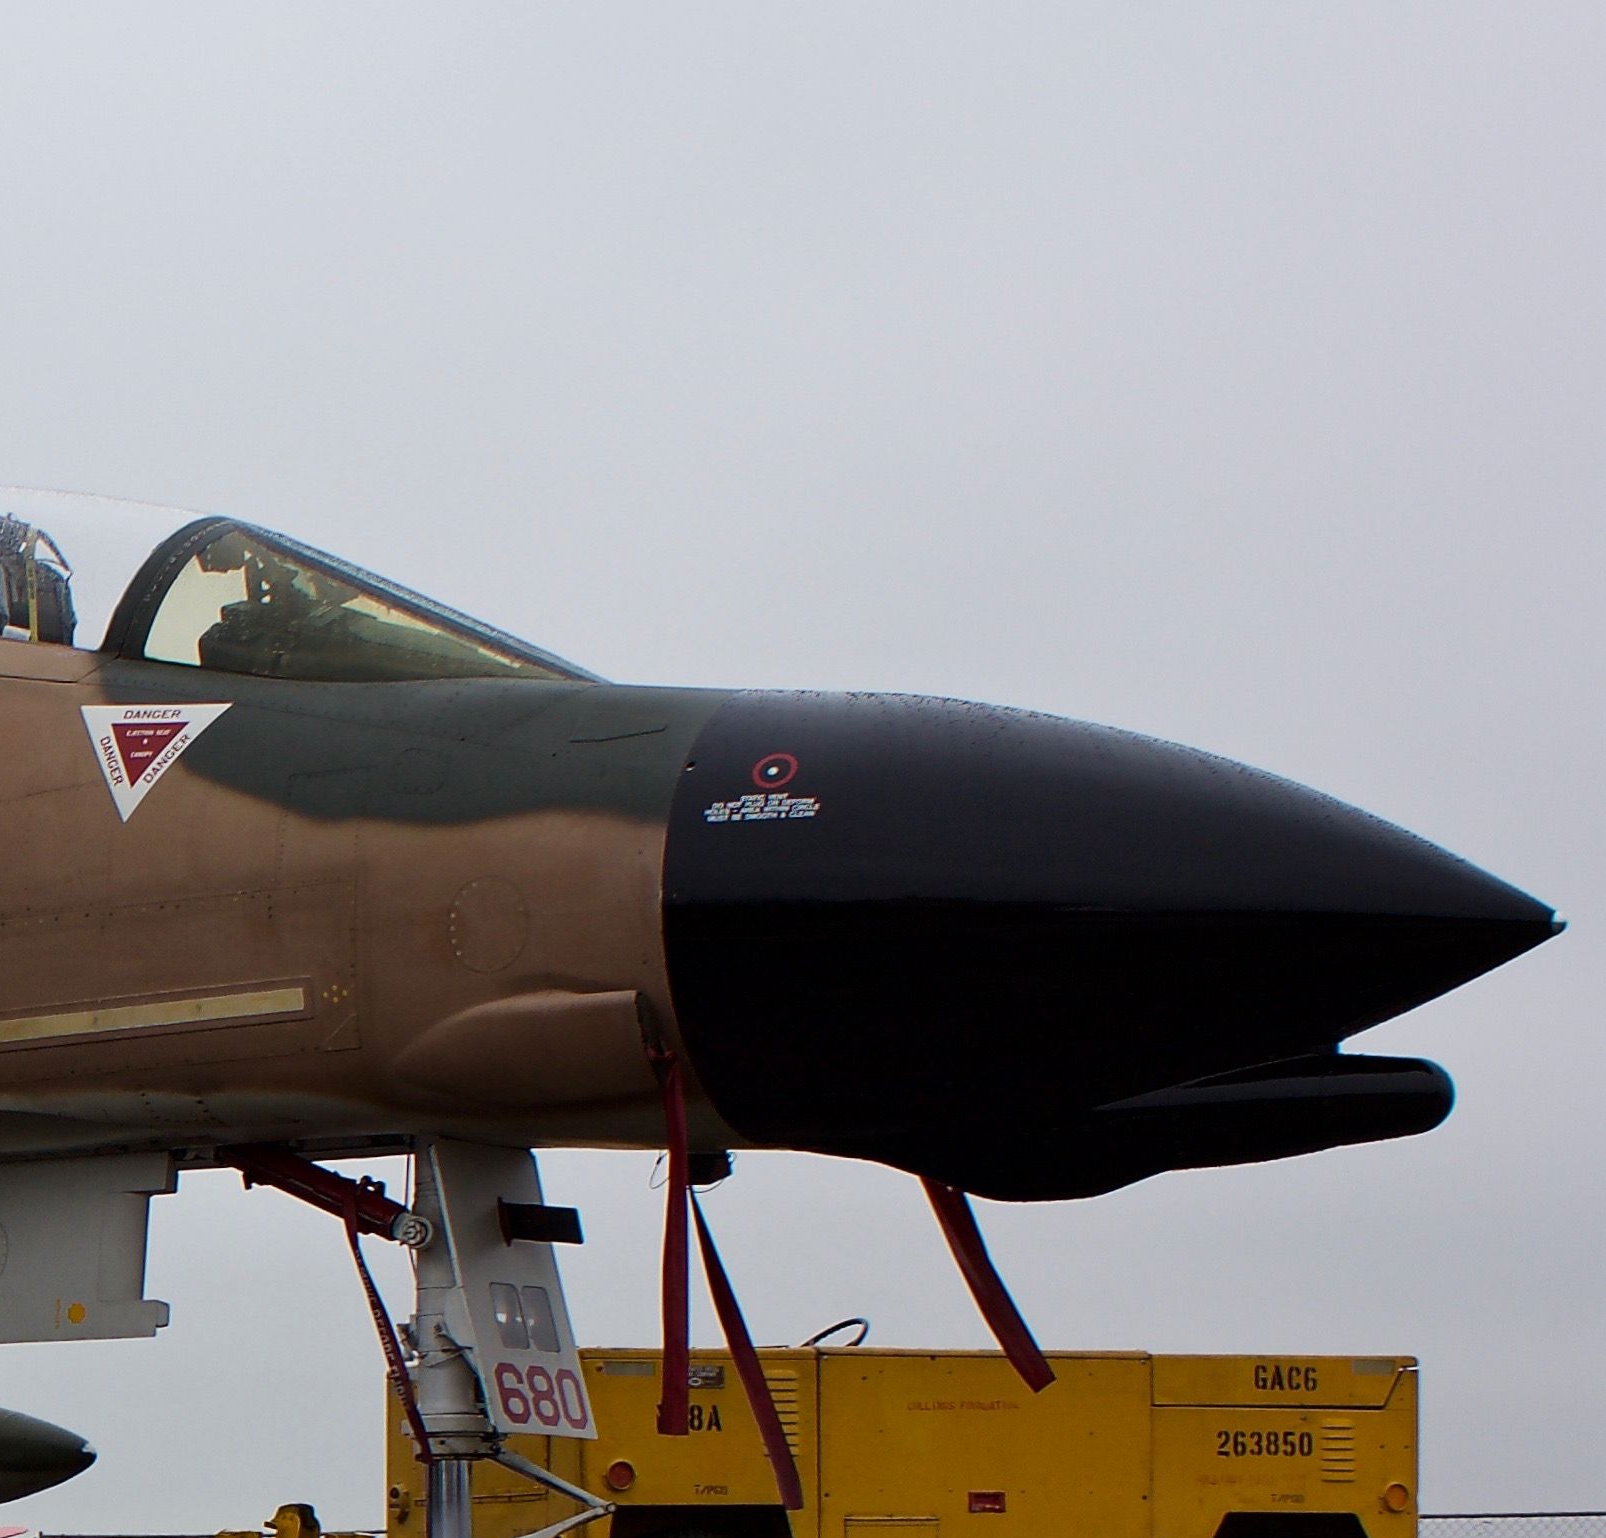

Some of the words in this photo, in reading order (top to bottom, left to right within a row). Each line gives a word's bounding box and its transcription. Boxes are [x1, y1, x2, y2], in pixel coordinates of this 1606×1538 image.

[123, 709, 182, 720] DANGER
[100, 736, 124, 786] DANGER
[143, 734, 191, 784] DANGER
[494, 1362, 589, 1430] 680
[1216, 1430, 1314, 1457] 263850
